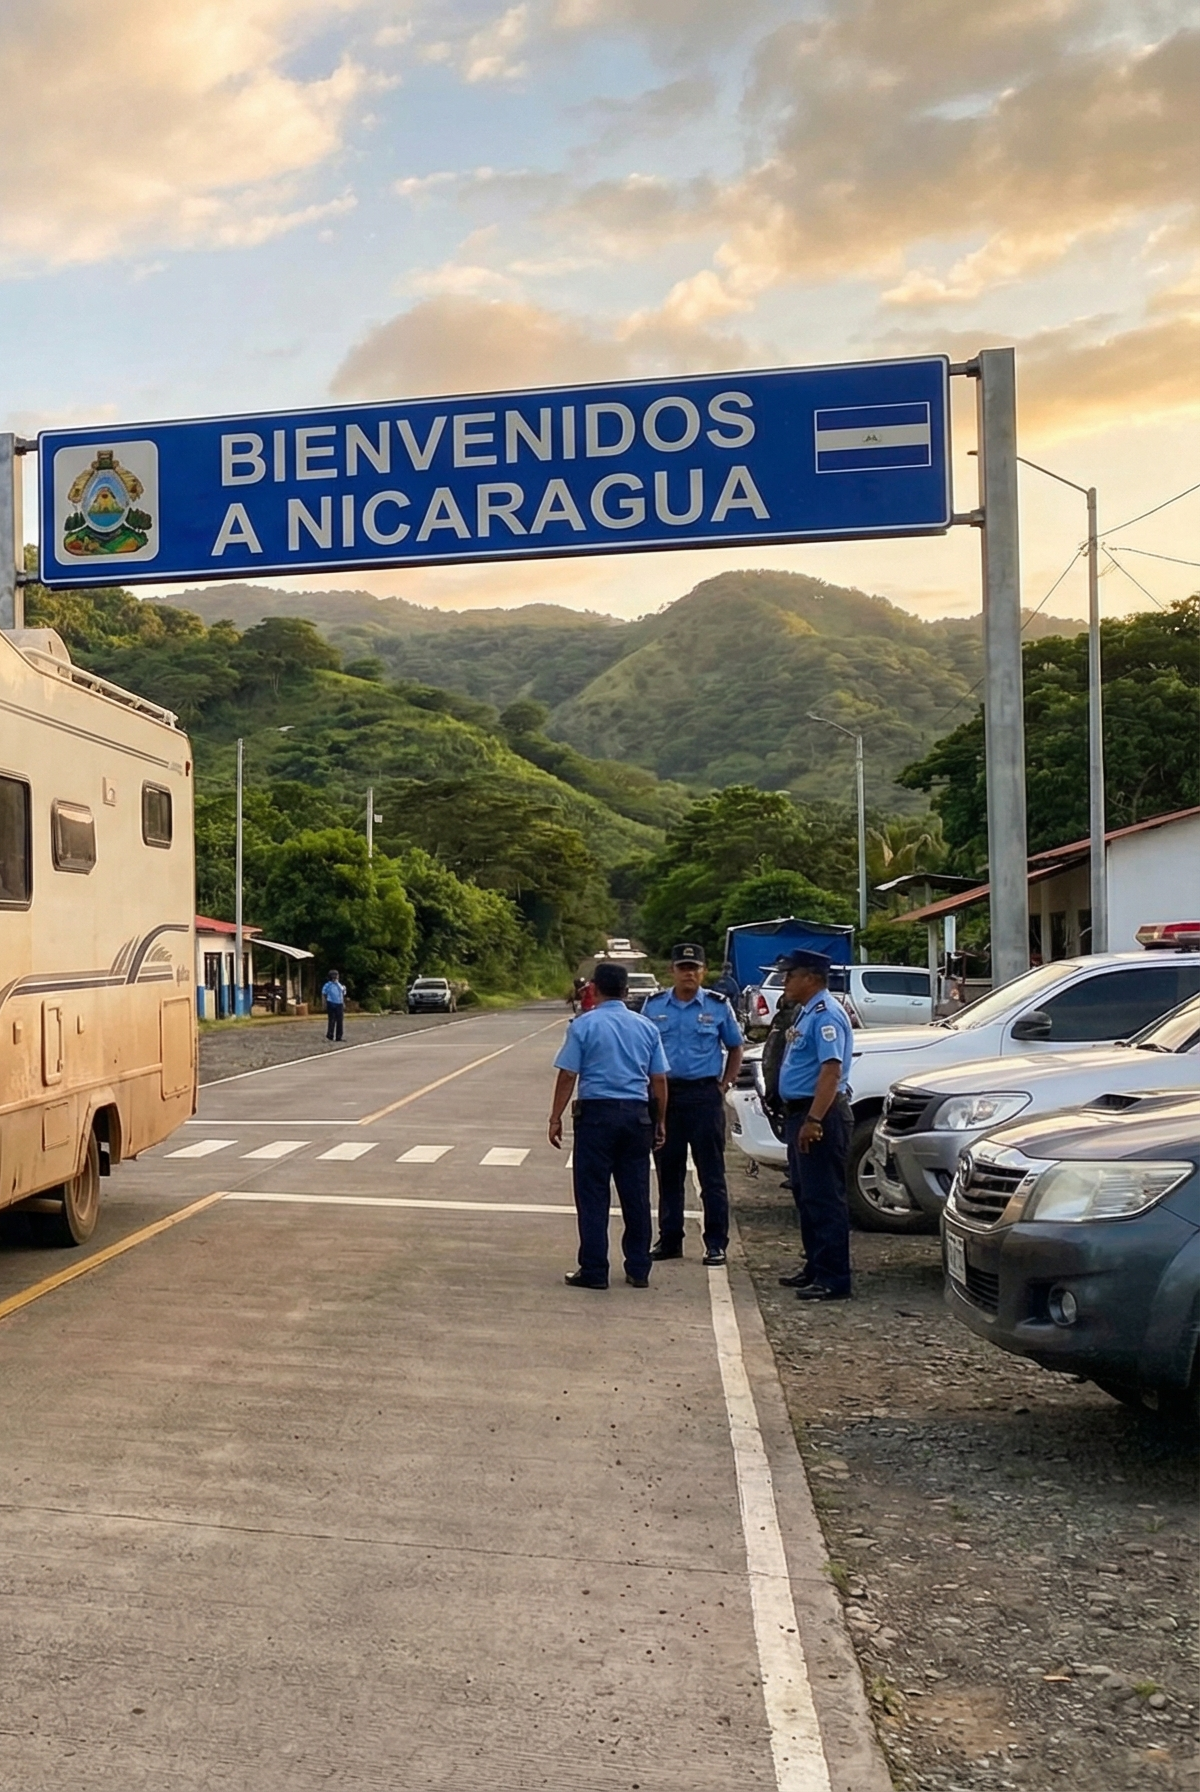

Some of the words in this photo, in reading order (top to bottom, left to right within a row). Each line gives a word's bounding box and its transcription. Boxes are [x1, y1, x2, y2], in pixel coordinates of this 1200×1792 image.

[221, 391, 756, 487] BIENVENIDOS
[211, 502, 263, 557] A
[287, 465, 771, 551] NICARAGUA
